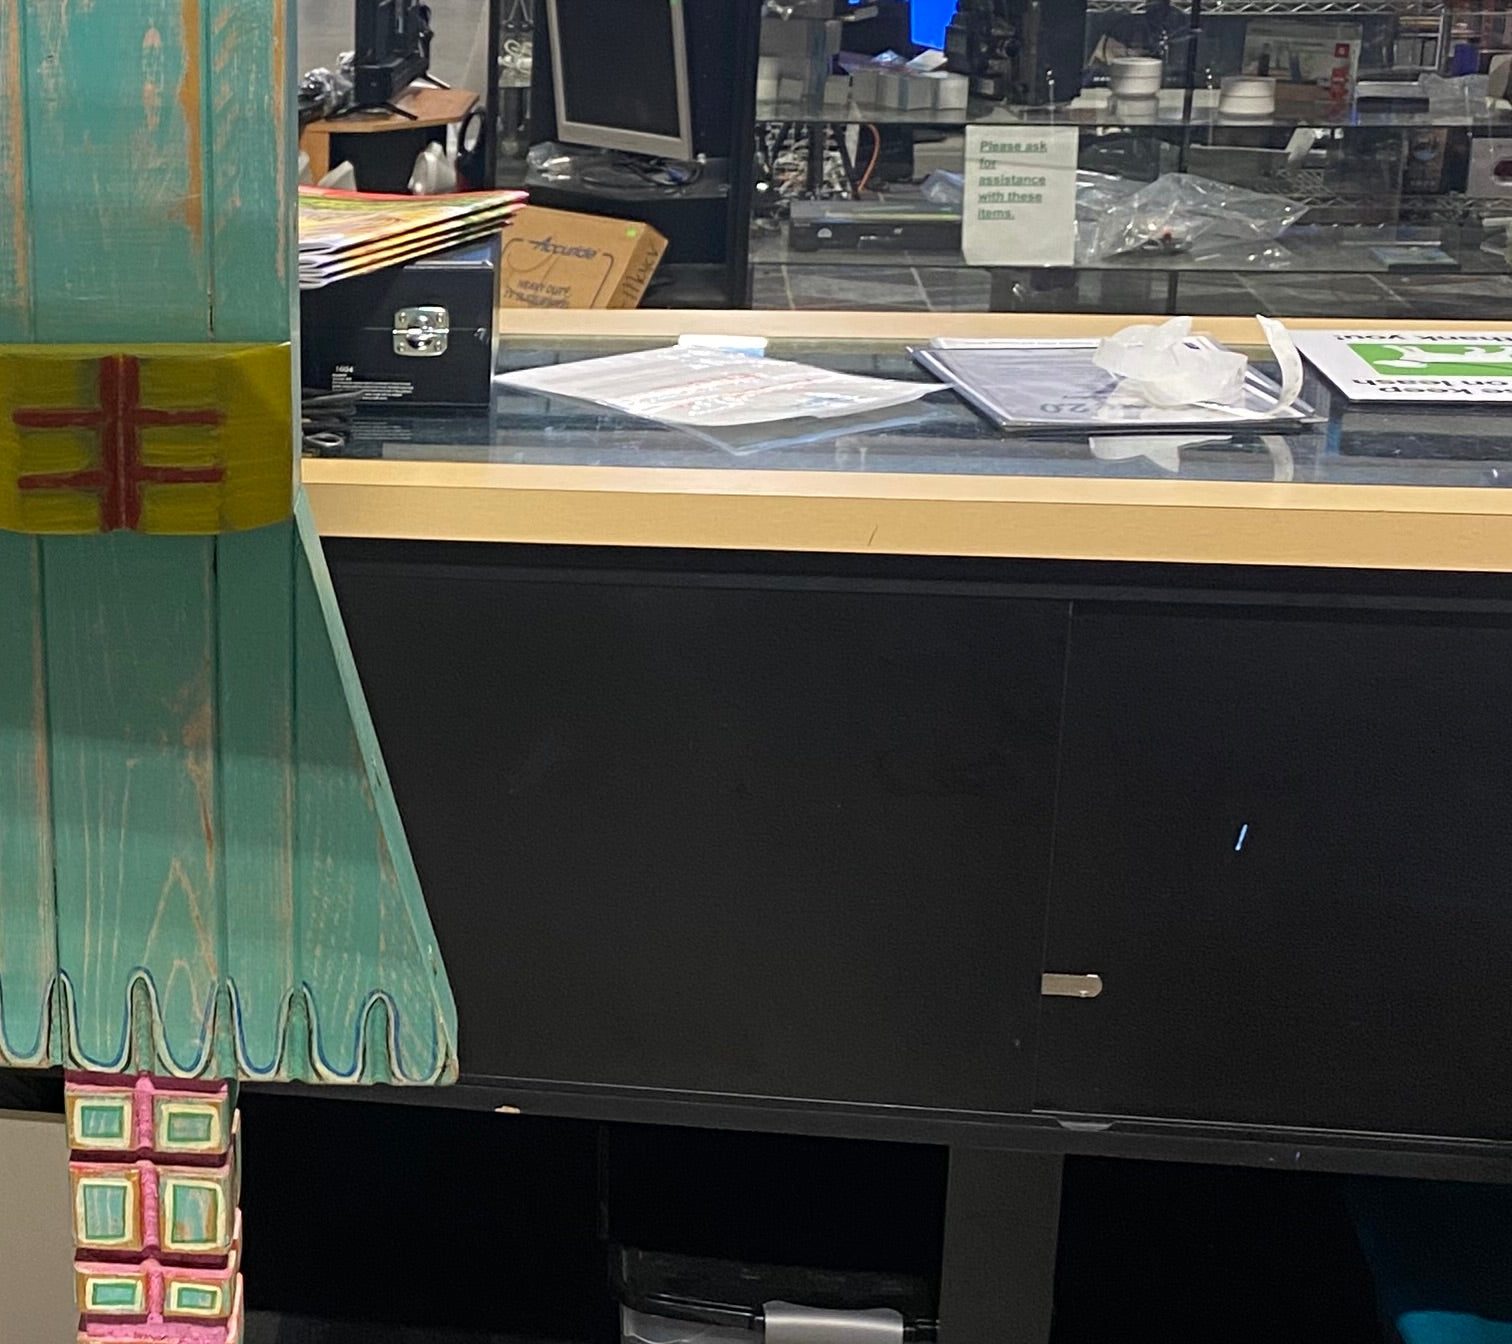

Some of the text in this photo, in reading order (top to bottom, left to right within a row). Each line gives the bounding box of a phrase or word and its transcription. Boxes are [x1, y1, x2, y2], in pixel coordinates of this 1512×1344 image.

[979, 140, 1048, 153] Please ask
[979, 158, 997, 170] for
[978, 174, 1046, 186] assistance
[978, 191, 1043, 203] with these
[977, 208, 1015, 220] items.
